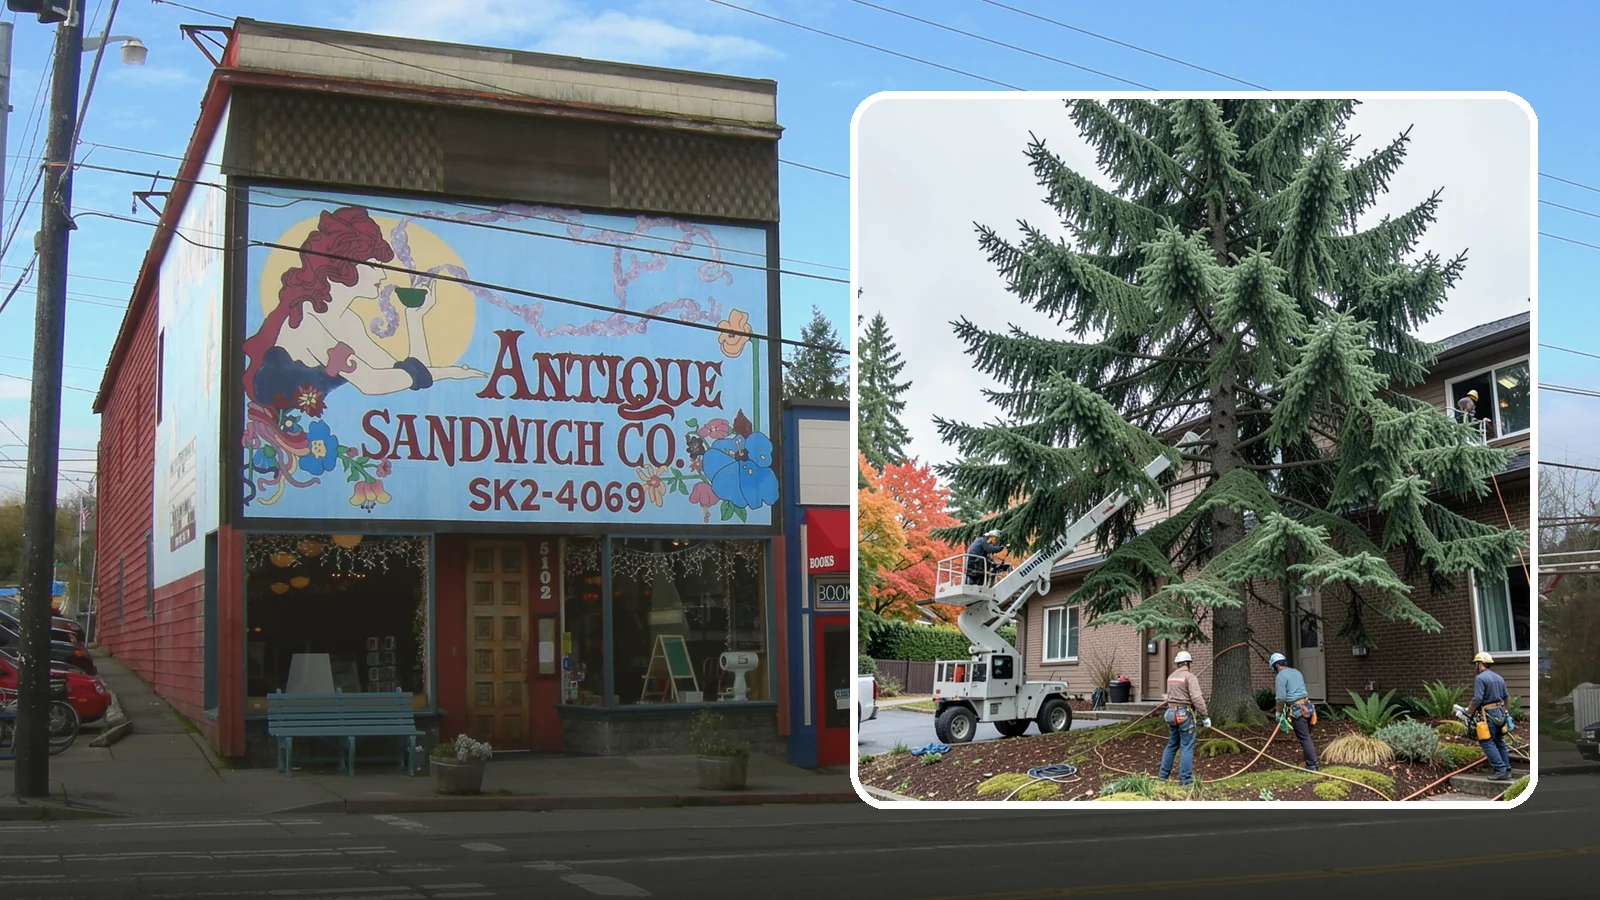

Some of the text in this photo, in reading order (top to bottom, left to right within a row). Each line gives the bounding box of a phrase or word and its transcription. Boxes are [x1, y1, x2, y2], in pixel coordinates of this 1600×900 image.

[476, 329, 723, 421] ANTIQUE
[361, 408, 685, 469] SANDWICH CO.
[469, 477, 645, 513] SK2-4069
[539, 541, 552, 600] 5102
[810, 555, 834, 568] BOOKS
